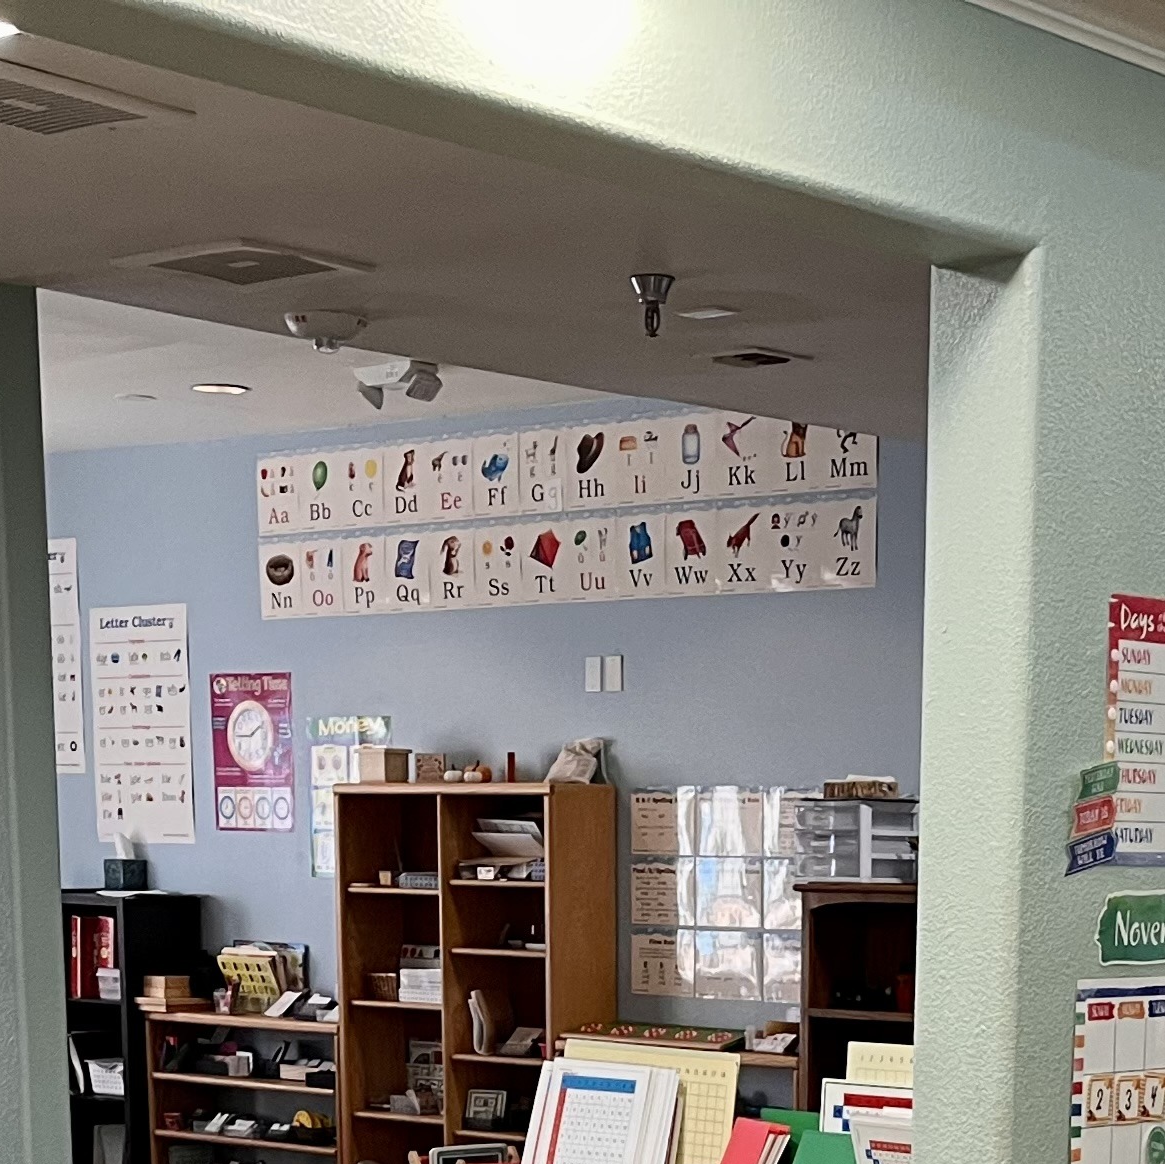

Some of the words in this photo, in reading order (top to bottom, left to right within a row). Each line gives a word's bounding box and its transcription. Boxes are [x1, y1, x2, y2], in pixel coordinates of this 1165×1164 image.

[268, 507, 290, 525] Aa
[309, 502, 331, 521] Bb
[352, 499, 373, 518] Cc
[394, 494, 418, 514] Dd
[440, 491, 463, 511] Ee
[487, 485, 508, 506] Ff
[578, 479, 605, 499] Hh
[680, 469, 701, 494] Jj
[728, 465, 756, 486] Kk
[785, 460, 806, 482] Ll
[830, 457, 869, 478] Mm
[271, 592, 293, 610] Nn
[312, 589, 334, 607] Oo
[354, 586, 375, 608] Pp
[396, 585, 420, 605] Qq
[443, 581, 464, 600] Rr
[488, 578, 510, 597] Ss
[535, 574, 556, 594] Tt
[580, 571, 606, 592] Uu
[629, 568, 653, 588] Vv
[674, 565, 708, 585] Ww
[727, 562, 757, 583] Xx
[781, 558, 807, 584] Yy
[835, 556, 861, 577] Zz
[99, 617, 129, 630] Letter
[1120, 602, 1155, 640] Days
[1121, 646, 1151, 665] SUNDAY
[226, 676, 261, 696] Telling
[261, 675, 288, 691] Time
[1121, 678, 1152, 696] MONDAY
[1119, 707, 1153, 726] TUESDAY
[1117, 737, 1163, 756] WEDNESDAY
[1121, 768, 1156, 785] HURSDAY
[1095, 1088, 1104, 1111] 2
[1124, 1088, 1132, 1111] 3
[1150, 1085, 1158, 1108] 4
